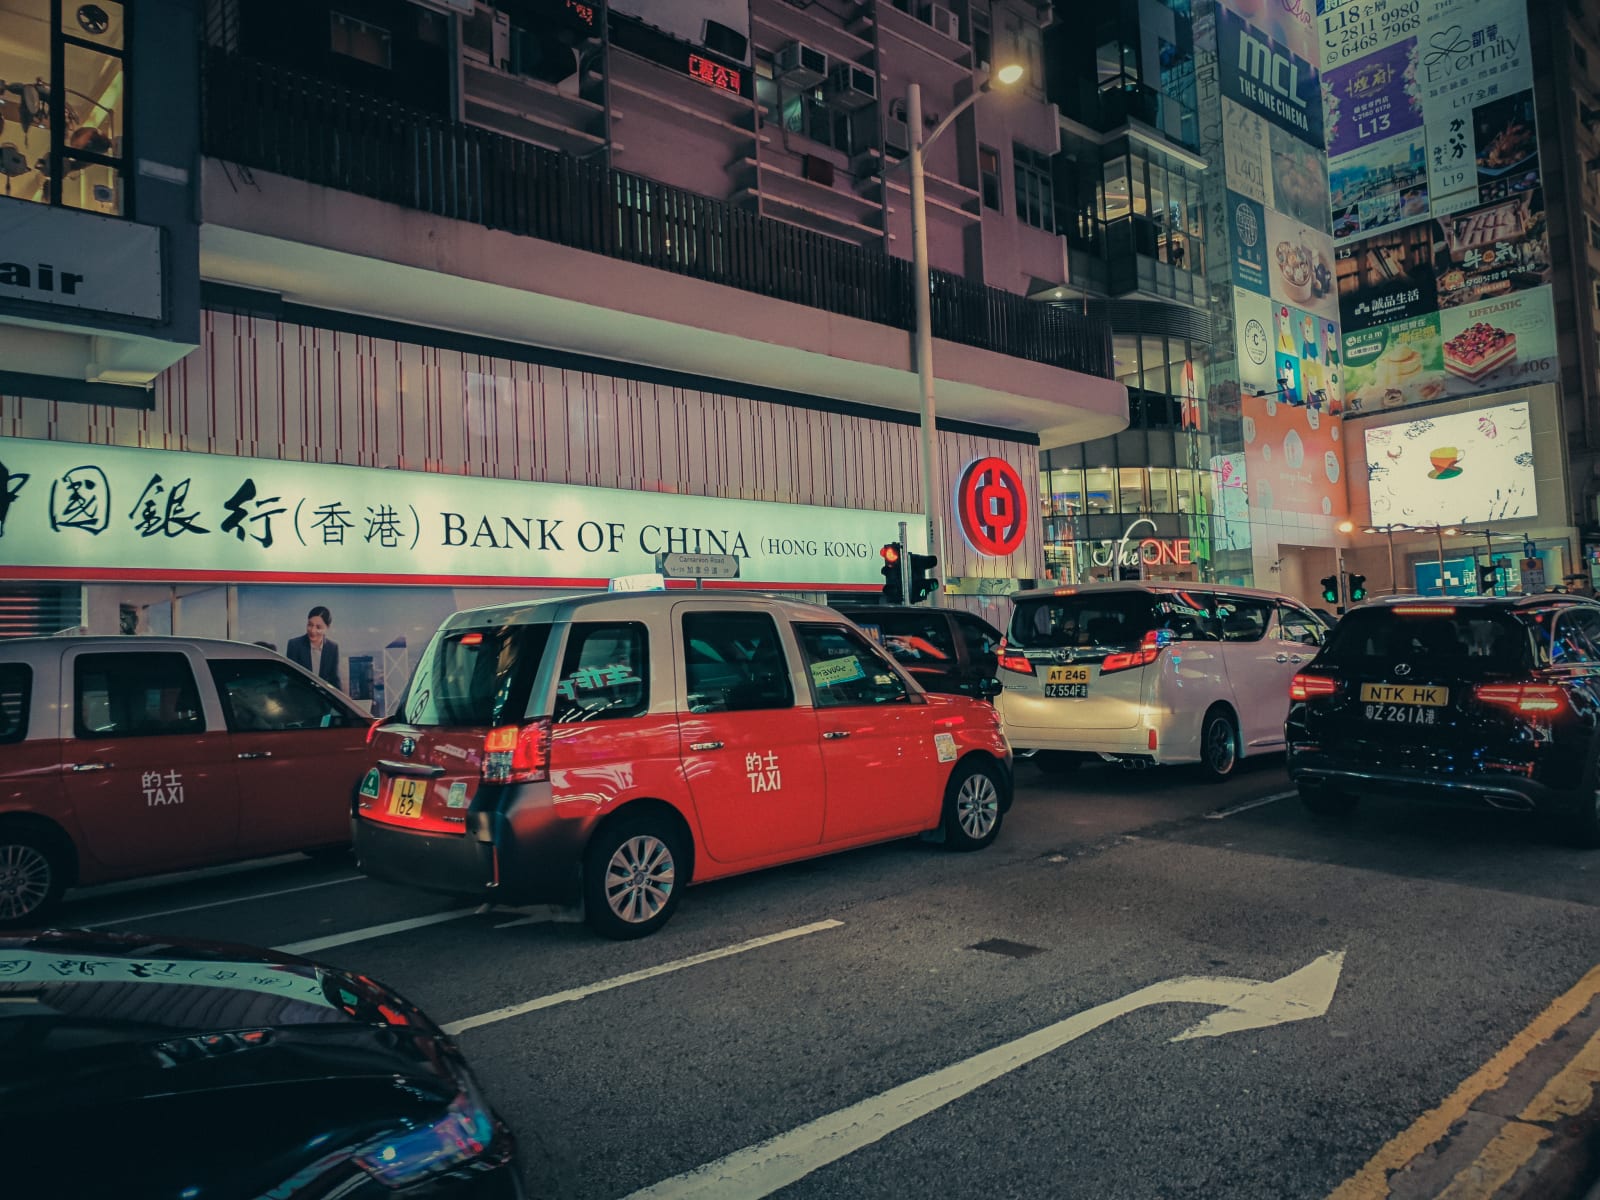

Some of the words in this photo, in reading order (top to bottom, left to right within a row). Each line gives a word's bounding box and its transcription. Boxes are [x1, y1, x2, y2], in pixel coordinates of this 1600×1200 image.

[1325, 5, 1360, 35] L18
[1341, 18, 1375, 44] 2811
[1381, 0, 1419, 27] 9980
[1341, 32, 1378, 57] 6468
[1382, 14, 1420, 40] 7968
[1239, 75, 1257, 101] THE
[1257, 87, 1276, 113] ONE
[1275, 98, 1309, 132] CINEMA
[1358, 113, 1391, 139] L13
[1442, 172, 1464, 187] L19
[1339, 248, 1352, 259] L3
[1468, 300, 1522, 319] LIFETASTIC
[440, 512, 565, 551] BANK
[577, 521, 626, 553] OF
[639, 524, 752, 559] CHINA
[760, 535, 818, 557] (HONG
[823, 540, 875, 561] KONG)
[1093, 518, 1158, 567] The
[1140, 538, 1192, 566] ONE
[1050, 670, 1062, 680] AT
[1065, 670, 1087, 680] 246
[1370, 687, 1404, 701] NTK
[1413, 689, 1437, 702] HK
[745, 749, 779, 772] 的士
[142, 769, 182, 788] 的士
[401, 782, 417, 798] LD
[747, 770, 781, 793] TAXI
[142, 786, 184, 807] TAXI
